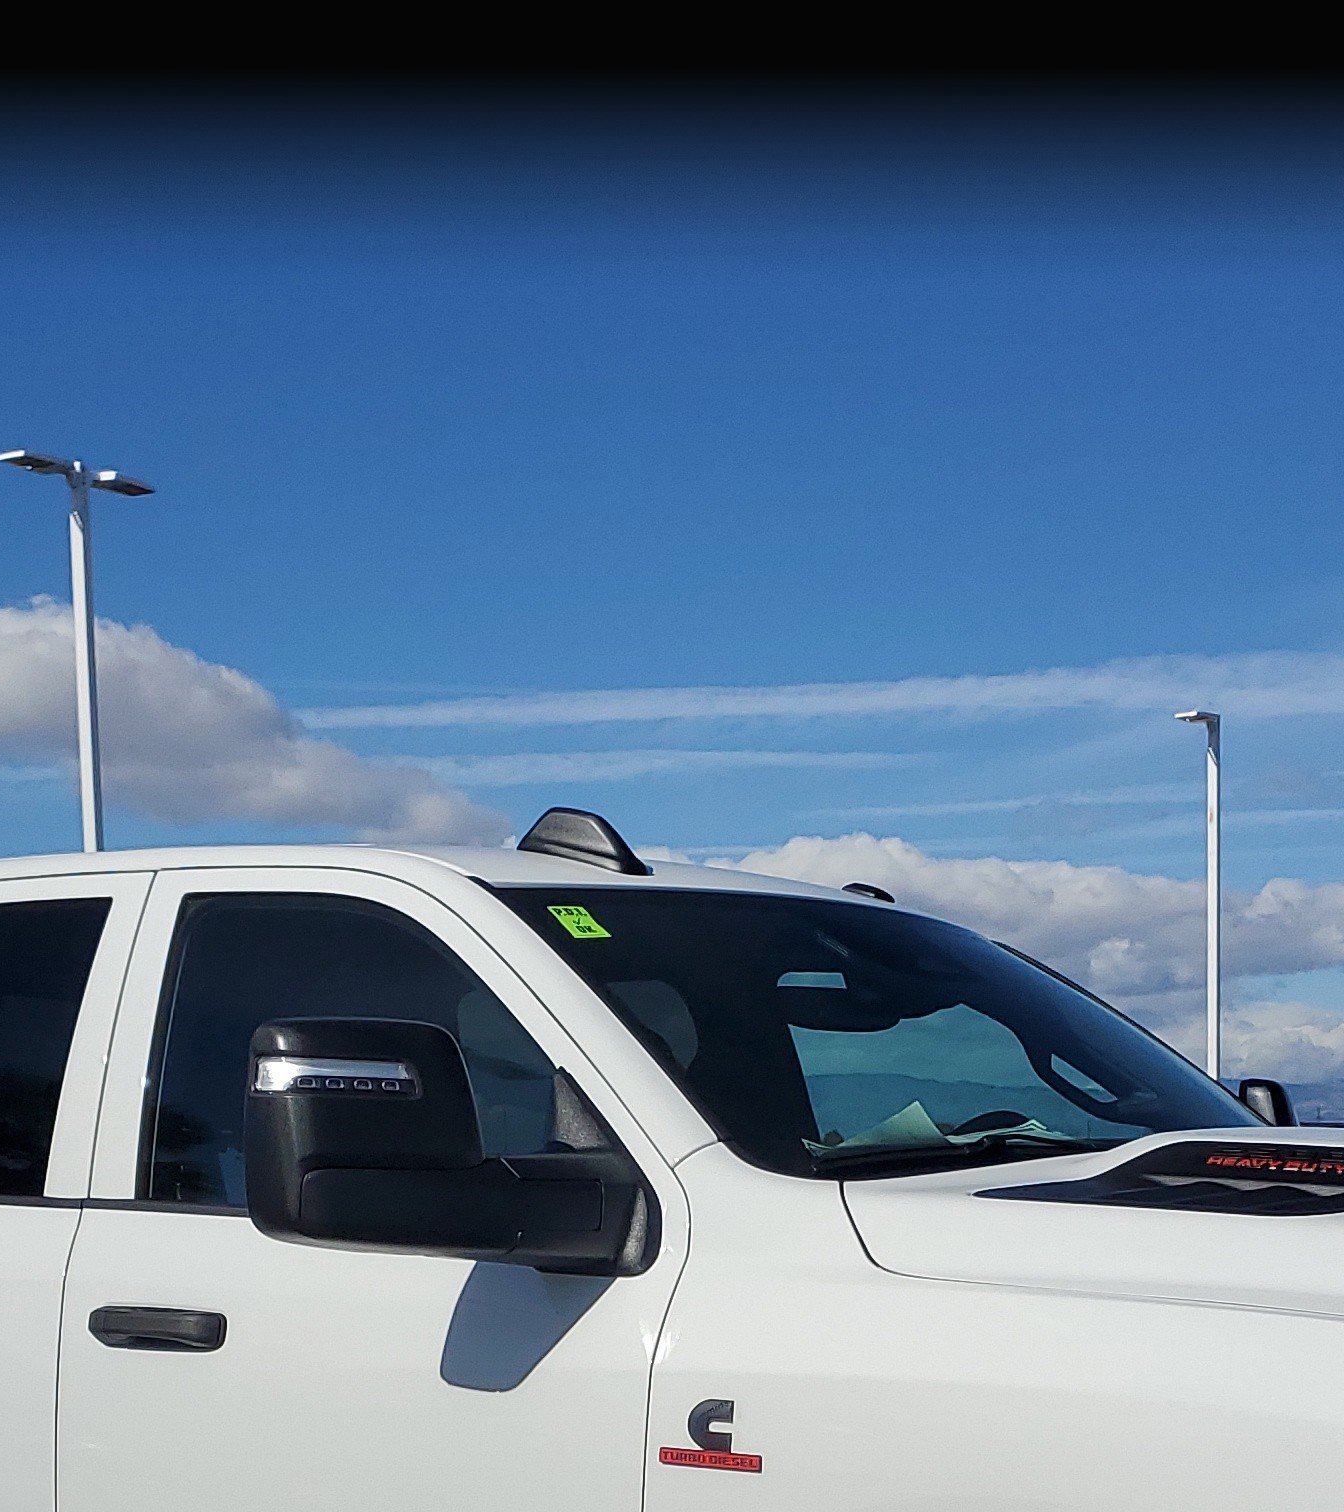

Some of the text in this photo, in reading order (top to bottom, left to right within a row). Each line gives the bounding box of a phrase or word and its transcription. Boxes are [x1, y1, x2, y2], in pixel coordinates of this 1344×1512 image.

[1206, 1156, 1283, 1170] HEAVY
[662, 1451, 758, 1468] TURBO DIESEL
